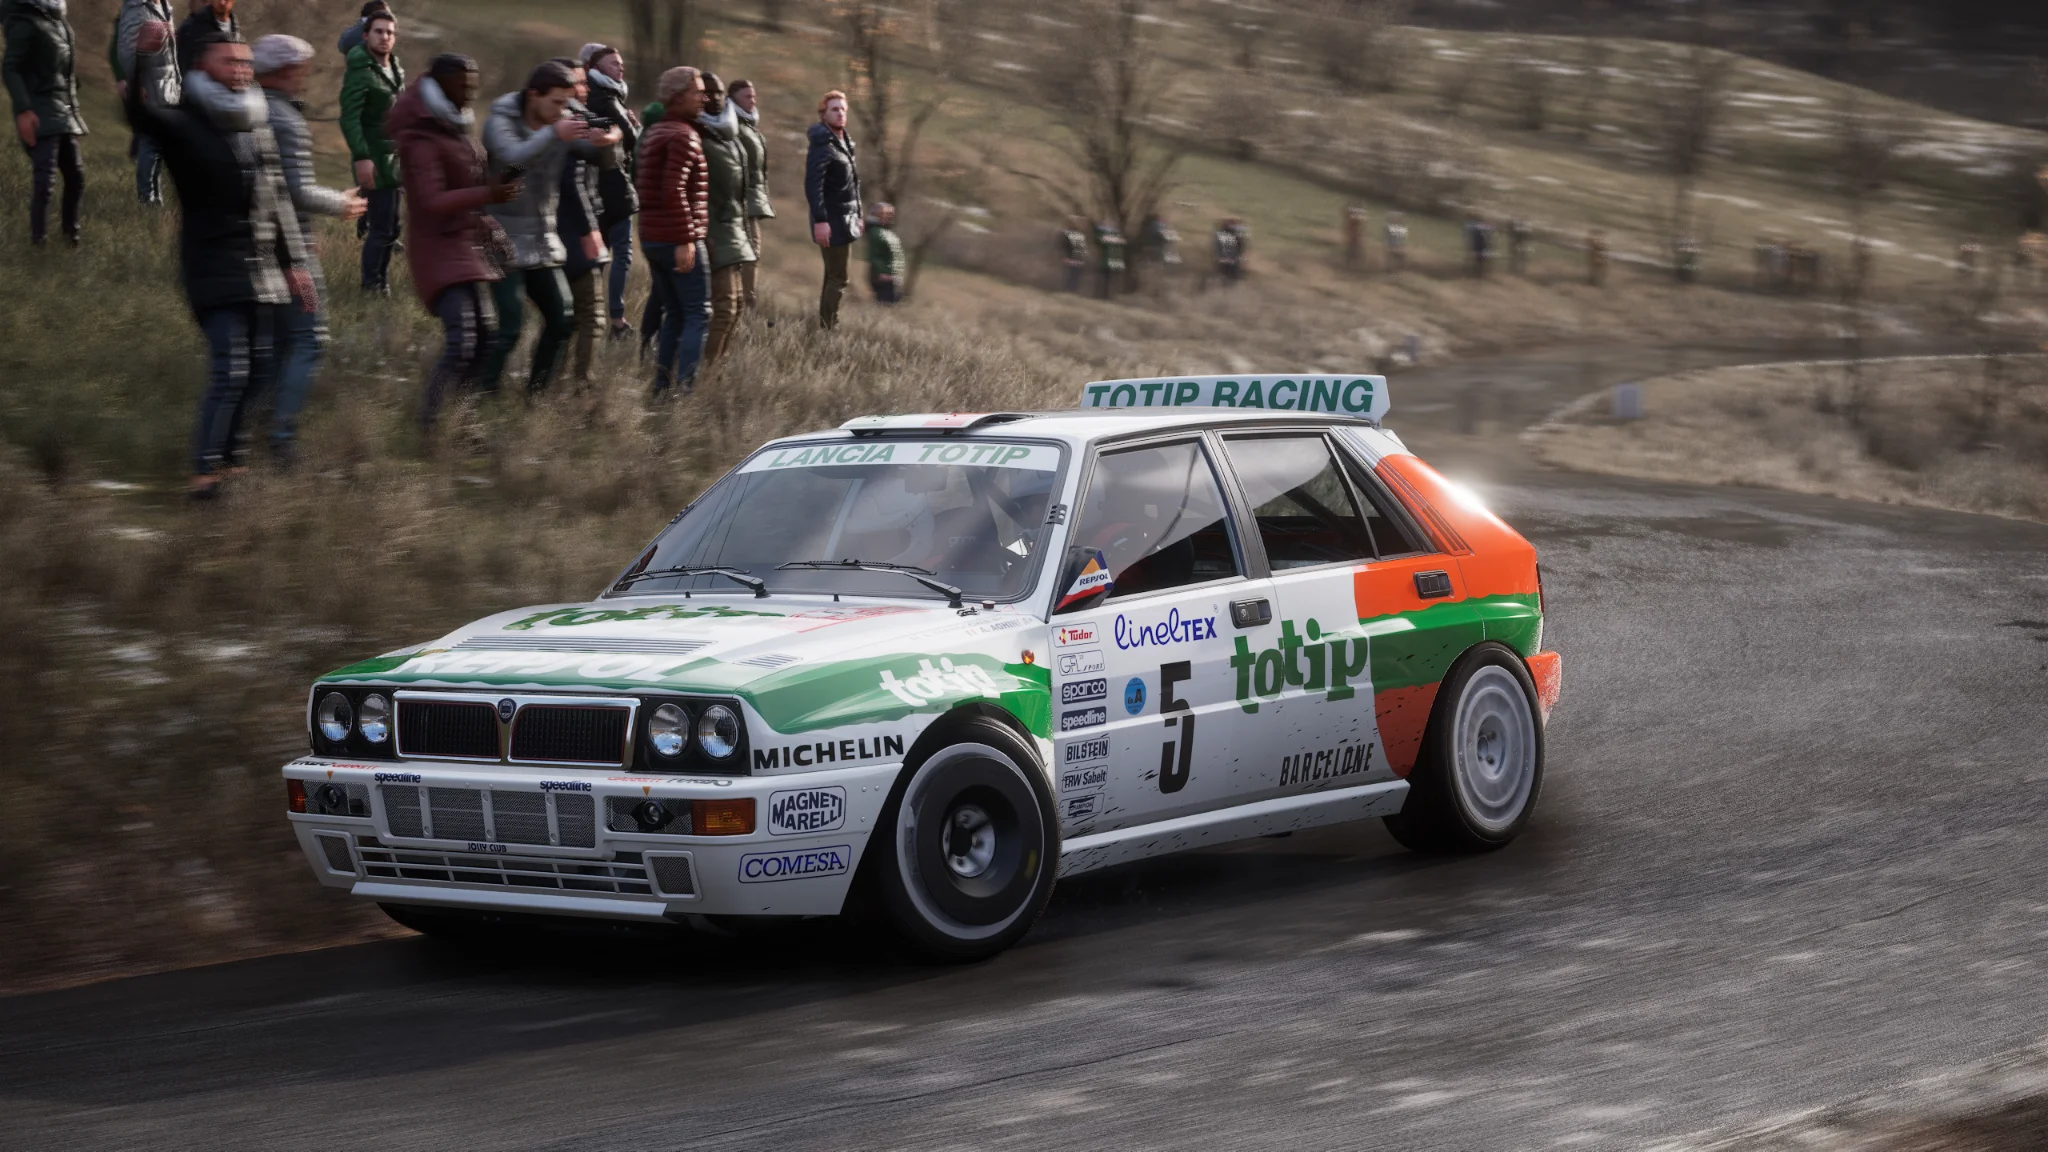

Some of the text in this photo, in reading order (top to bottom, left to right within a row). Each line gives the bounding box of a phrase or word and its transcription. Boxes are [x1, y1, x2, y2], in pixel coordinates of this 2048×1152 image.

[1088, 379, 1374, 413] TOTIP RACING
[768, 443, 1031, 468] LANCIA TOTIP
[1079, 573, 1109, 586] REPSOL
[1068, 629, 1093, 641] Tudor
[1230, 618, 1369, 714] totip
[879, 657, 1001, 706] totip
[1062, 681, 1106, 701] sparco
[1062, 709, 1106, 731] speedline
[1159, 660, 1195, 795] 5
[754, 735, 904, 770] MICHELIN
[1066, 740, 1109, 761] BILSTEIN
[1279, 742, 1375, 787] BARCELONE
[374, 772, 421, 784] speedline
[539, 780, 592, 792] speedline
[1082, 770, 1107, 785] Sabelt
[772, 791, 843, 819] MAGNETI
[772, 803, 842, 831] MARELLI
[489, 844, 507, 853] CLUB
[745, 852, 846, 878] COMESA
